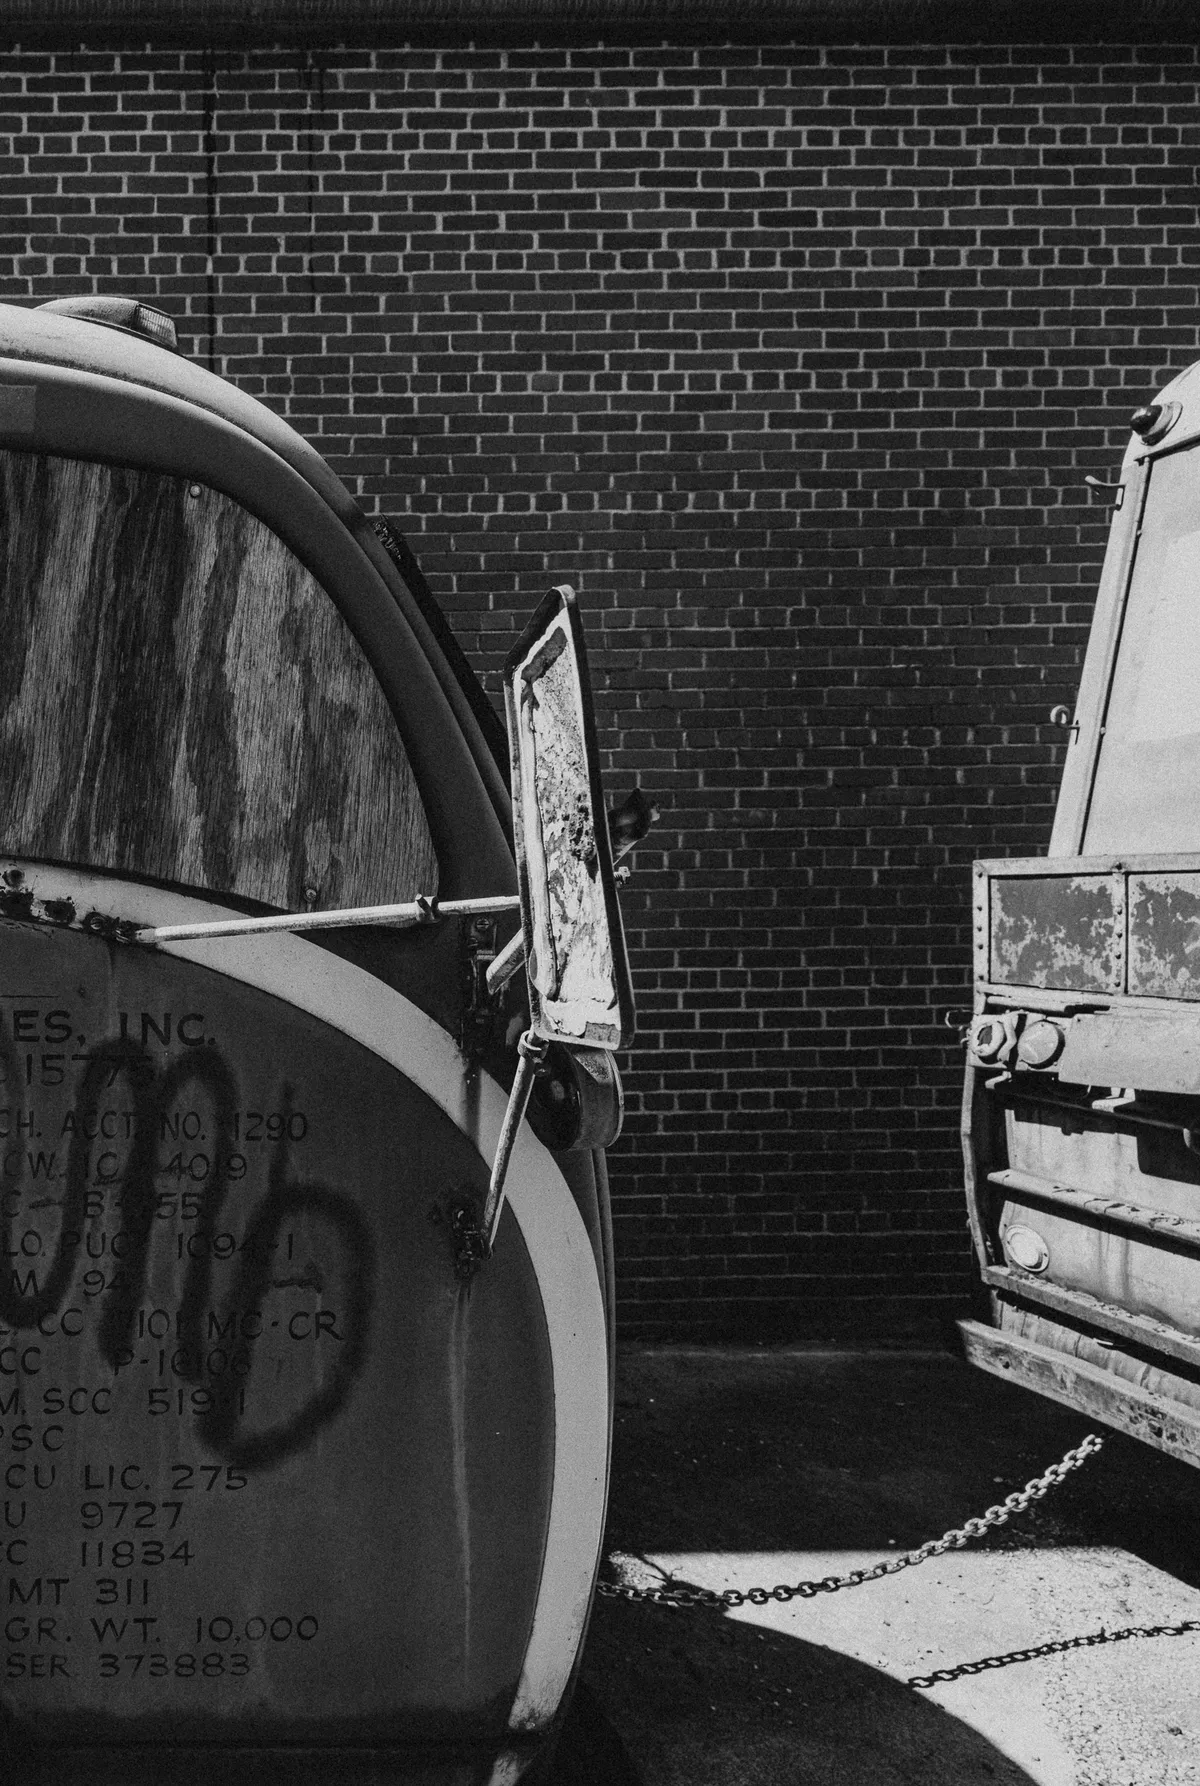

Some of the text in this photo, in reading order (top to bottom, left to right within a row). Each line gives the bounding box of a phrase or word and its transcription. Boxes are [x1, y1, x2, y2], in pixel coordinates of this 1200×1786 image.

[119, 1011, 218, 1048] INC.
[233, 1111, 309, 1142] 1290
[42, 1387, 112, 1415] SCC
[84, 1464, 151, 1491] LIC.
[171, 1463, 249, 1492] 275
[79, 1500, 185, 1530] 9727
[81, 1539, 196, 1568] 11834
[8, 1577, 150, 1606] MT 311
[4, 1616, 72, 1644] GR.
[90, 1616, 162, 1644] WT.
[98, 1652, 251, 1679] 373883
